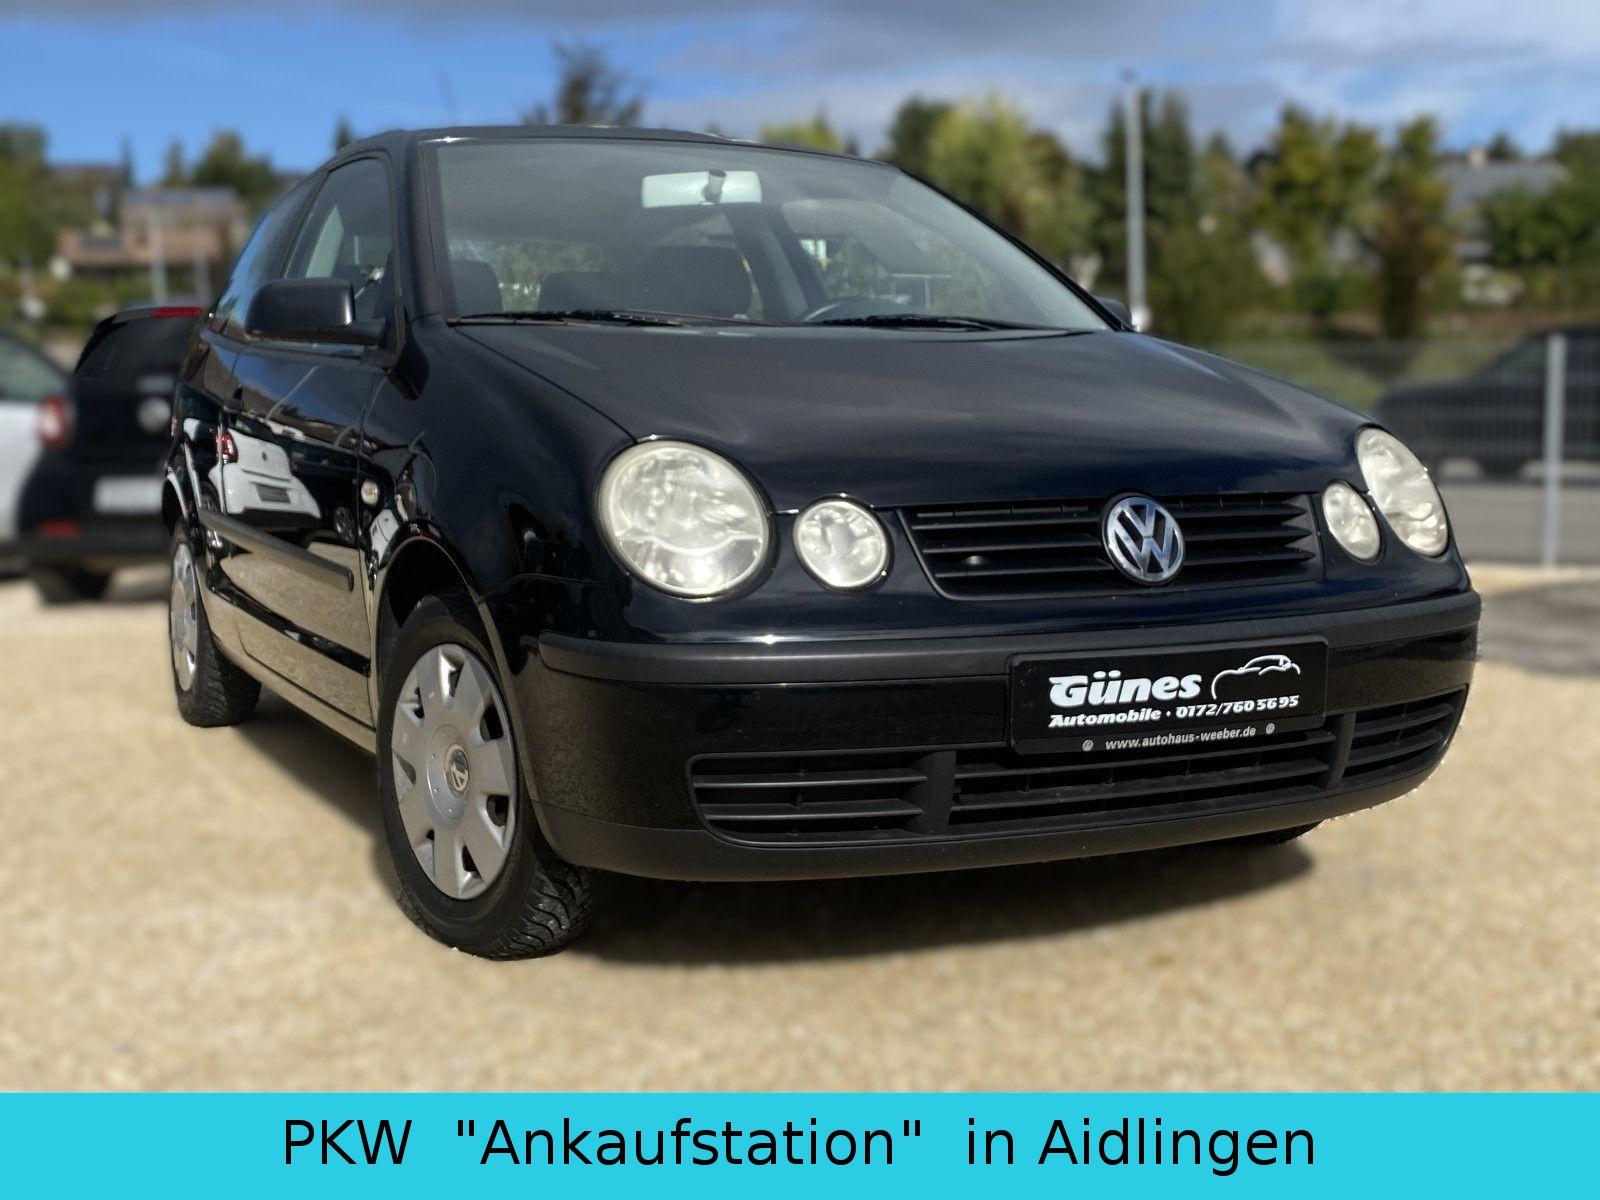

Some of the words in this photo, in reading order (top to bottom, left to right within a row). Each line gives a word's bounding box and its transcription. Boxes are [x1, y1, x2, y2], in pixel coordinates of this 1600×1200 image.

[1108, 499, 1184, 582] VW
[1049, 670, 1202, 708] Günes
[1048, 708, 1162, 729] Automobile
[1105, 726, 1257, 750] www.autohaus-weeber.de
